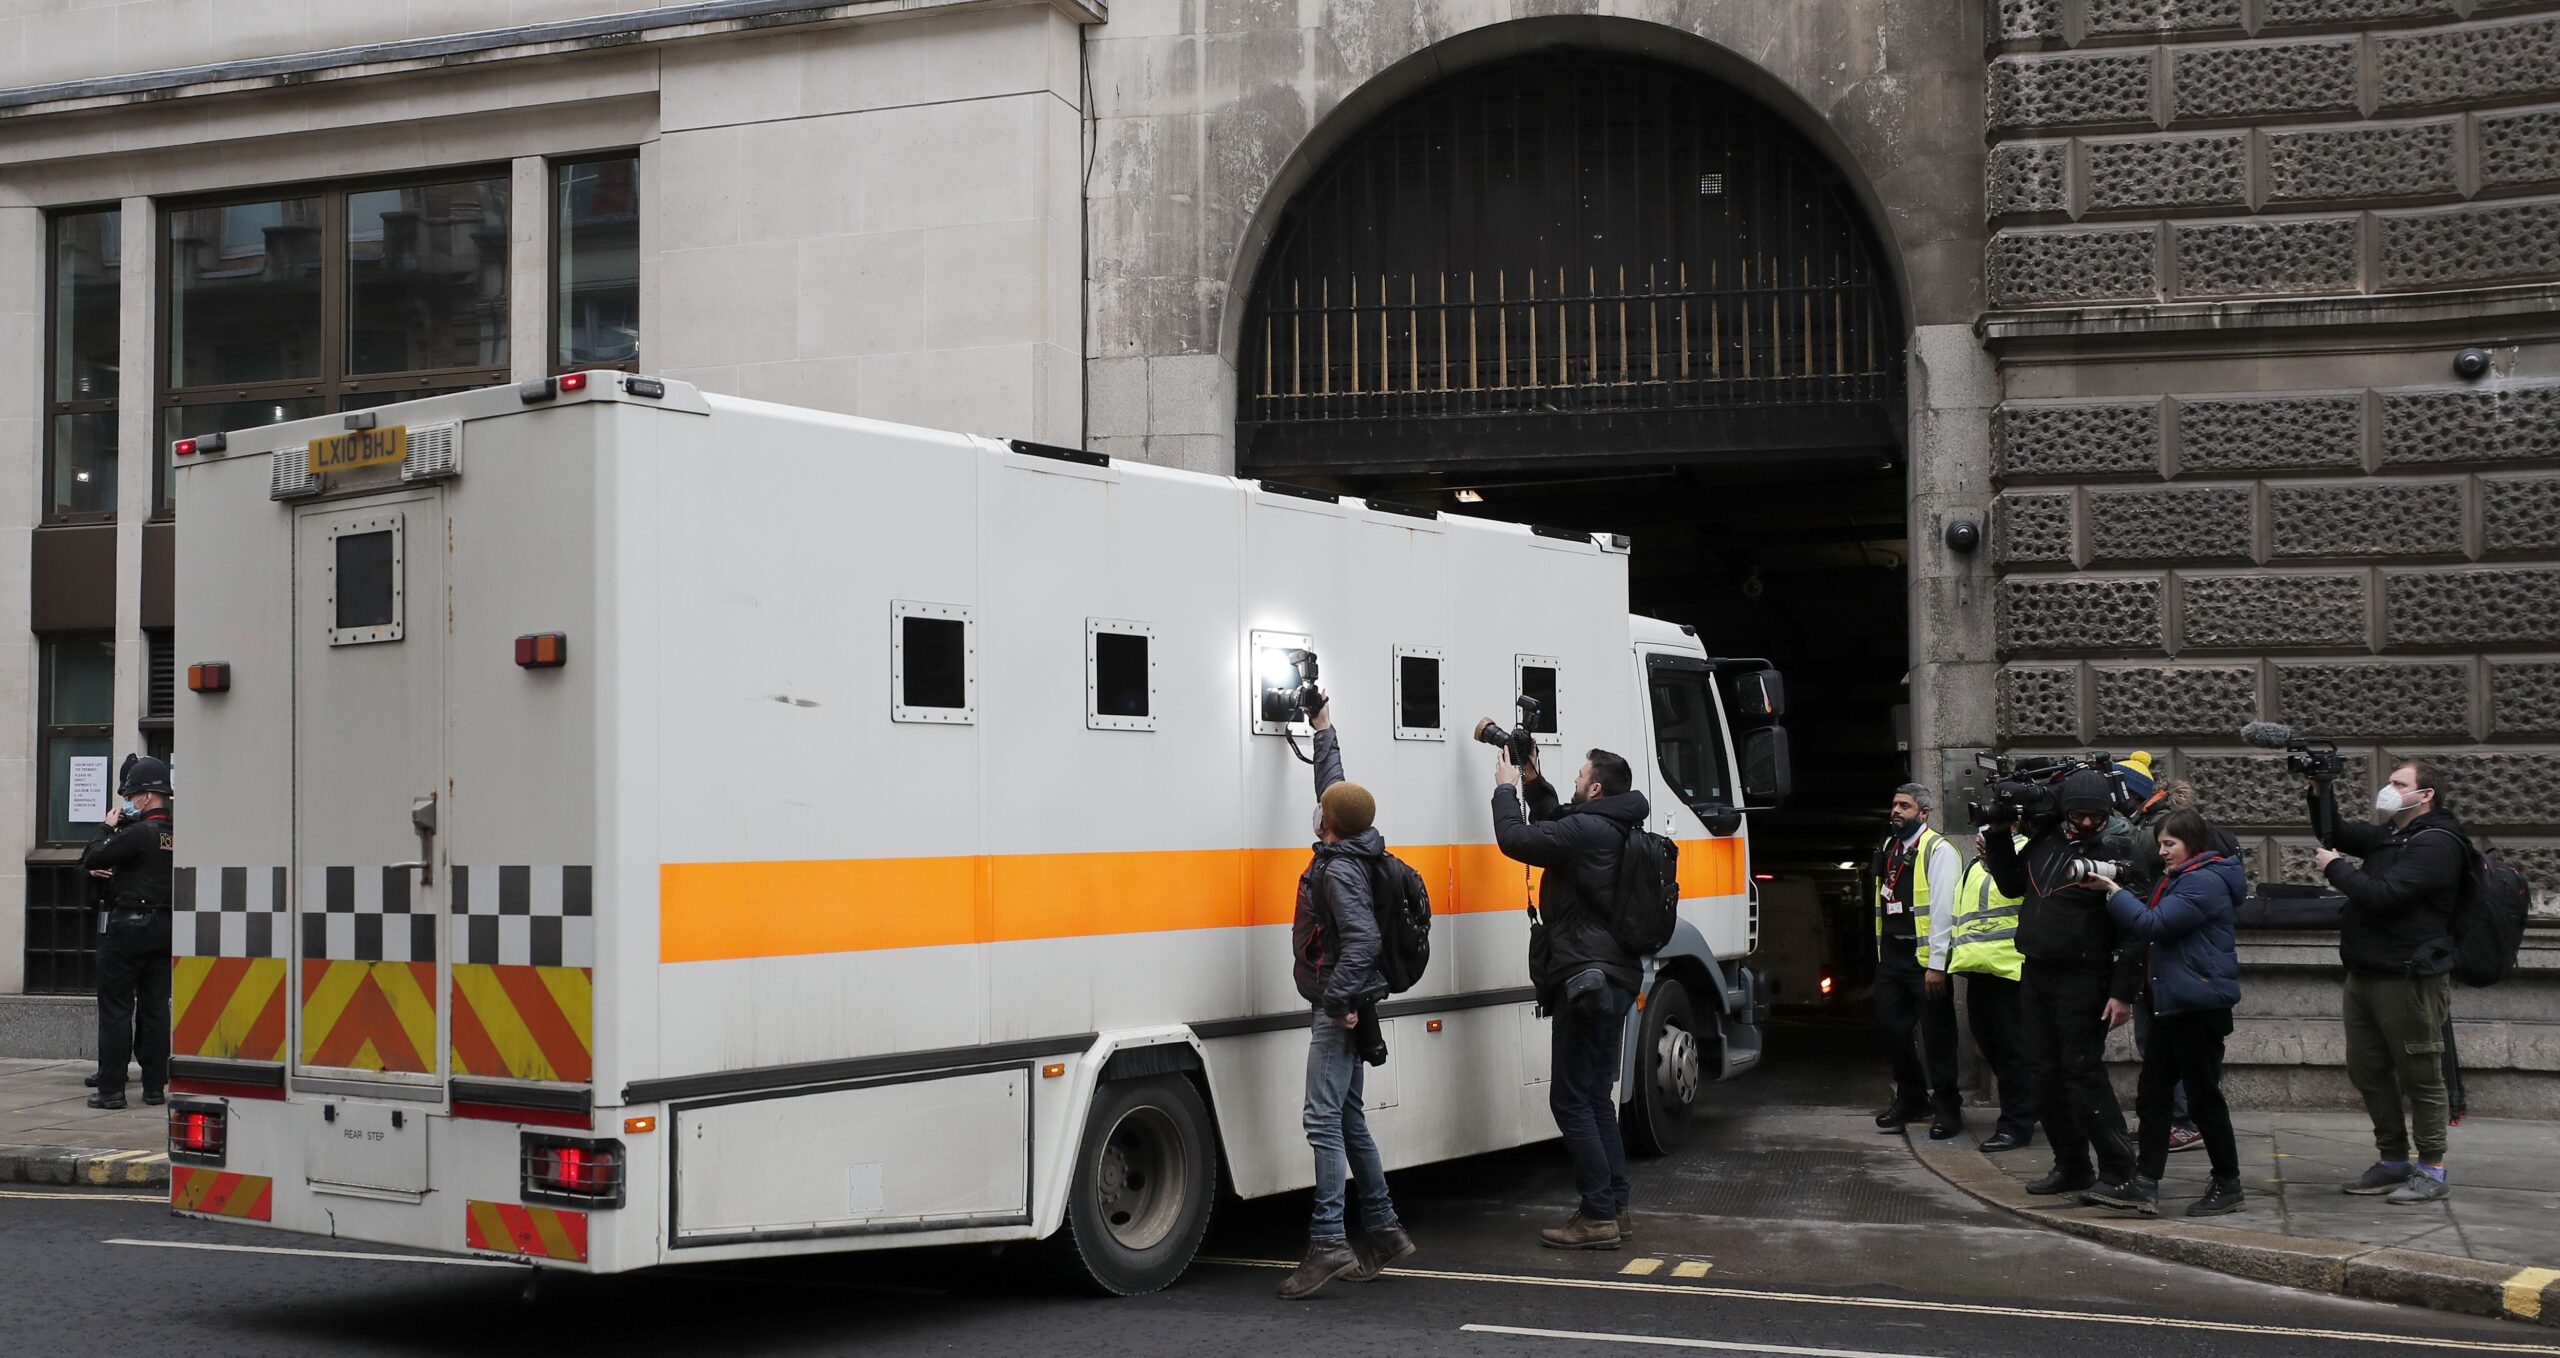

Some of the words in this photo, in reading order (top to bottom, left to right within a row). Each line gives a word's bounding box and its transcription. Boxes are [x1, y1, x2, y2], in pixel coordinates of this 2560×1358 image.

[317, 434, 357, 466] LX10
[363, 429, 397, 459] BHJ
[344, 1129, 362, 1139] REAR
[367, 1131, 384, 1141] STEP
